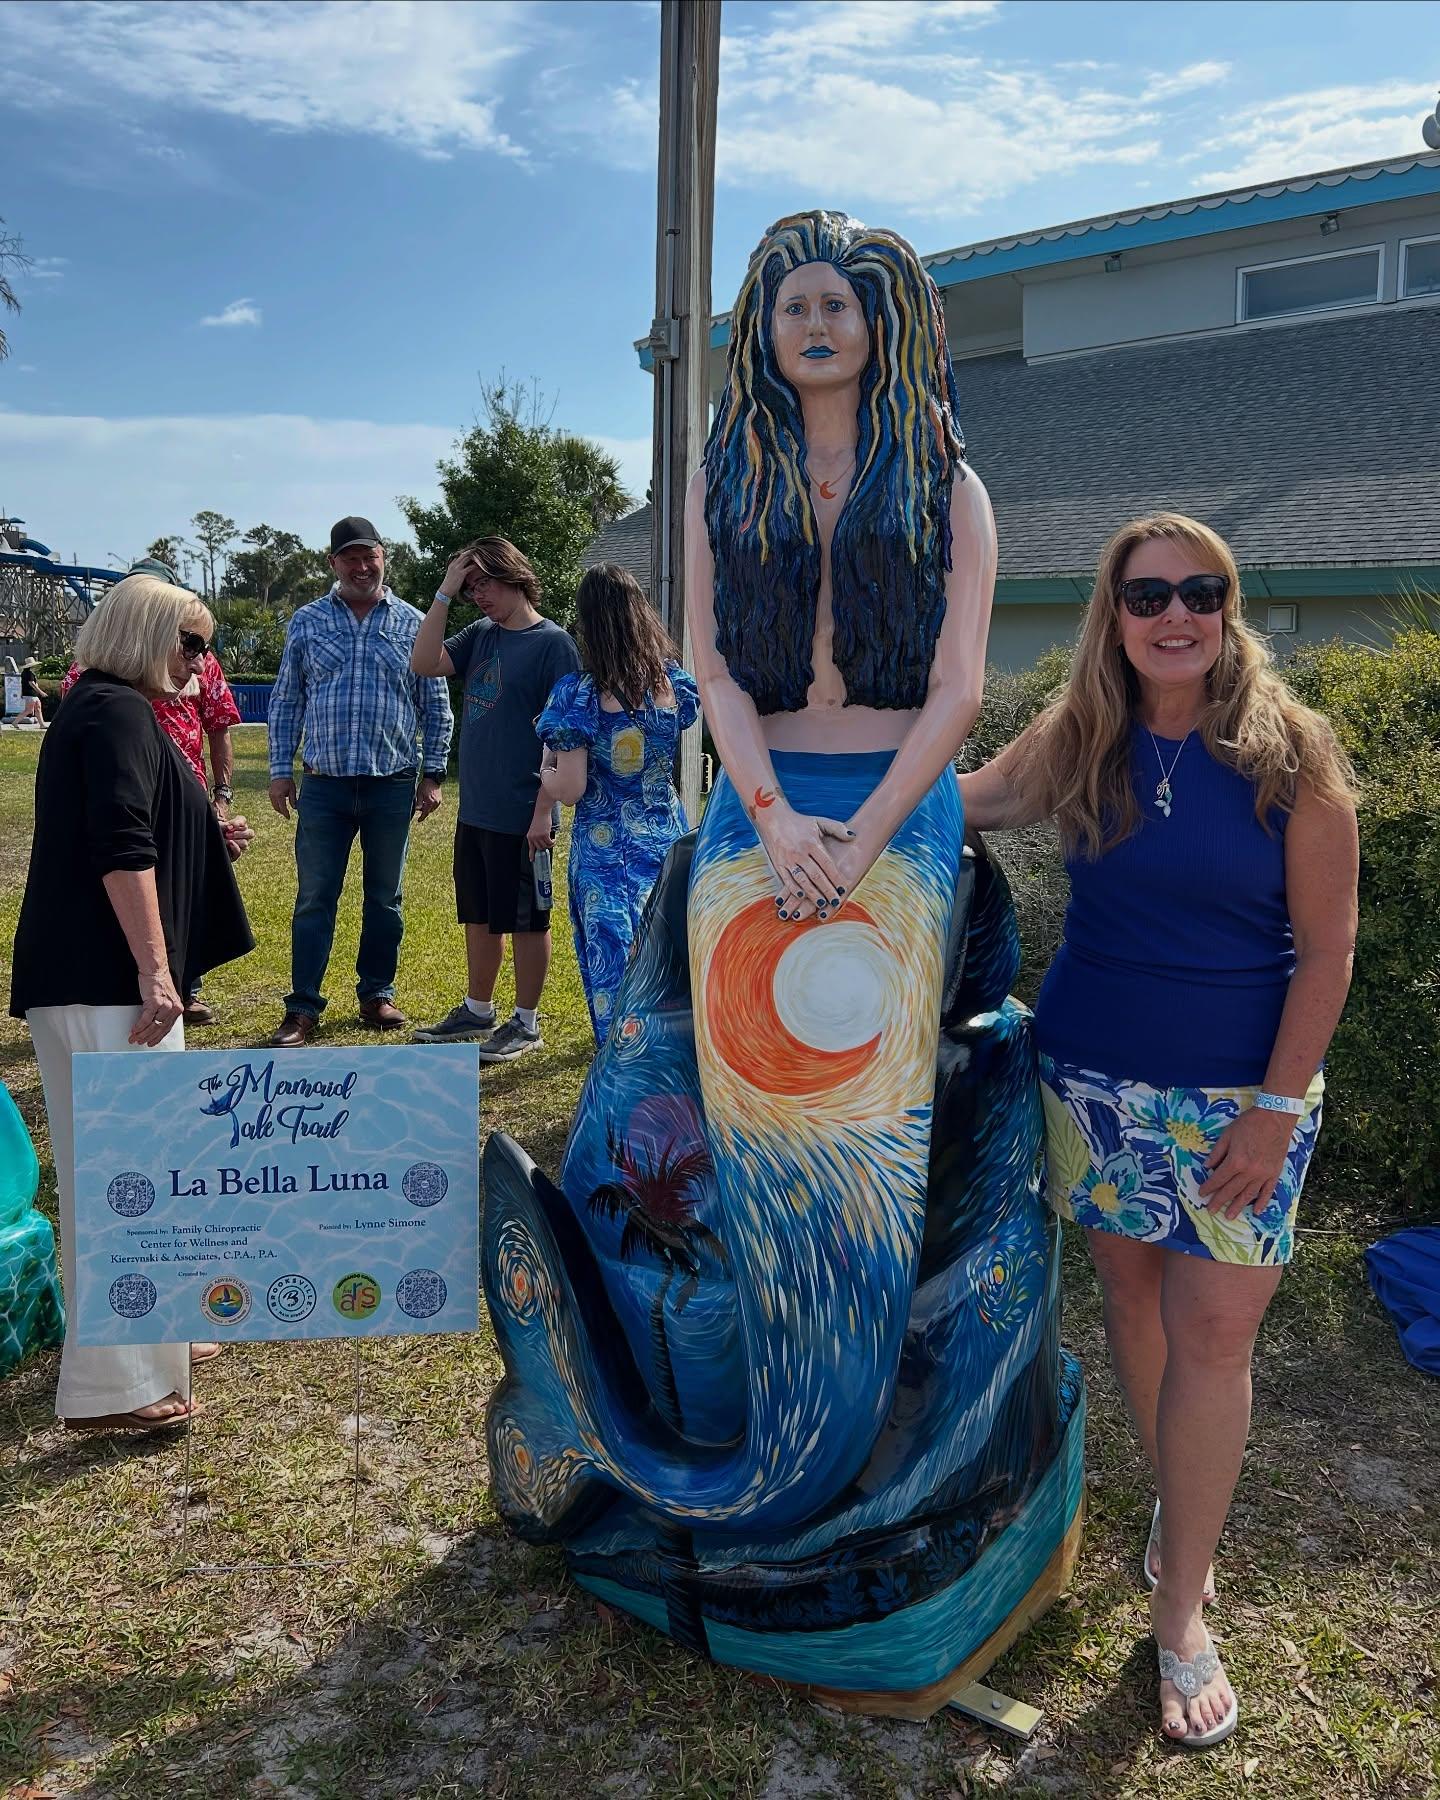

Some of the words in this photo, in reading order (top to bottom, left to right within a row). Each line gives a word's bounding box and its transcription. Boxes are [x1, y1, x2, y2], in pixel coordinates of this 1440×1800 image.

[199, 1073, 223, 1095] The
[226, 1060, 358, 1104] Mermaid
[204, 1100, 275, 1149] Tale
[276, 1102, 350, 1145] Trail
[168, 1169, 208, 1197] La
[217, 1165, 299, 1196] Bella
[307, 1164, 390, 1193] Luna
[172, 1225, 201, 1235] Family
[204, 1223, 262, 1234] Chiropractic
[355, 1219, 386, 1230] Lynne
[388, 1217, 426, 1228] Simone
[140, 1240, 171, 1249] Center
[174, 1238, 188, 1248] for
[189, 1238, 229, 1247] Wellness
[231, 1237, 248, 1246] and
[110, 1252, 159, 1264] Kierzynski
[160, 1253, 170, 1262] &
[173, 1252, 221, 1262] Associates,
[223, 1250, 256, 1261] C.P.A.,
[258, 1249, 277, 1259] P.A.
[271, 1277, 312, 1307] BROOKSVILLE
